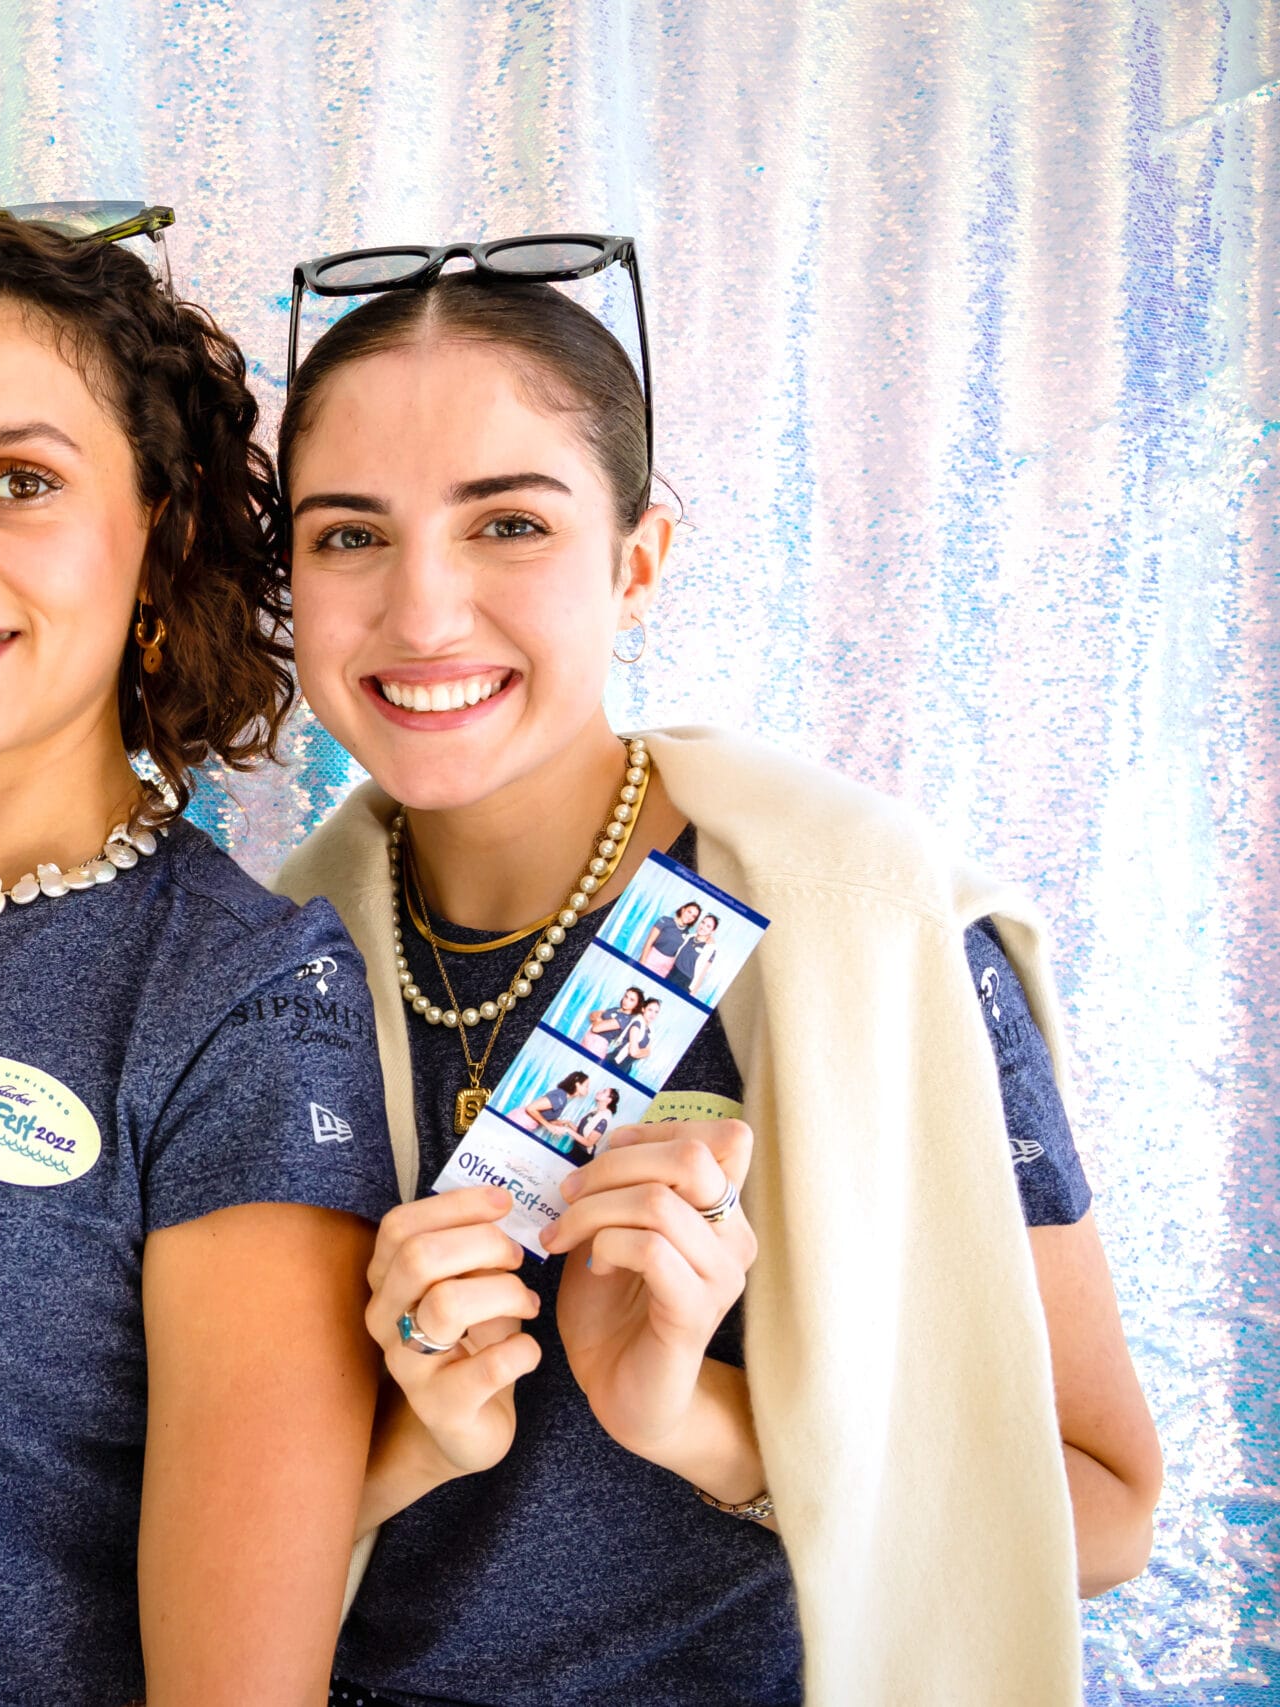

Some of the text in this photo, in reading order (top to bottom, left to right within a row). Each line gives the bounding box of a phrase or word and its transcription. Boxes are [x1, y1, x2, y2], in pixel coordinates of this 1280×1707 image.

[464, 1100, 478, 1120] S
[34, 1127, 76, 1154] 2022
[537, 1202, 561, 1221] 202
